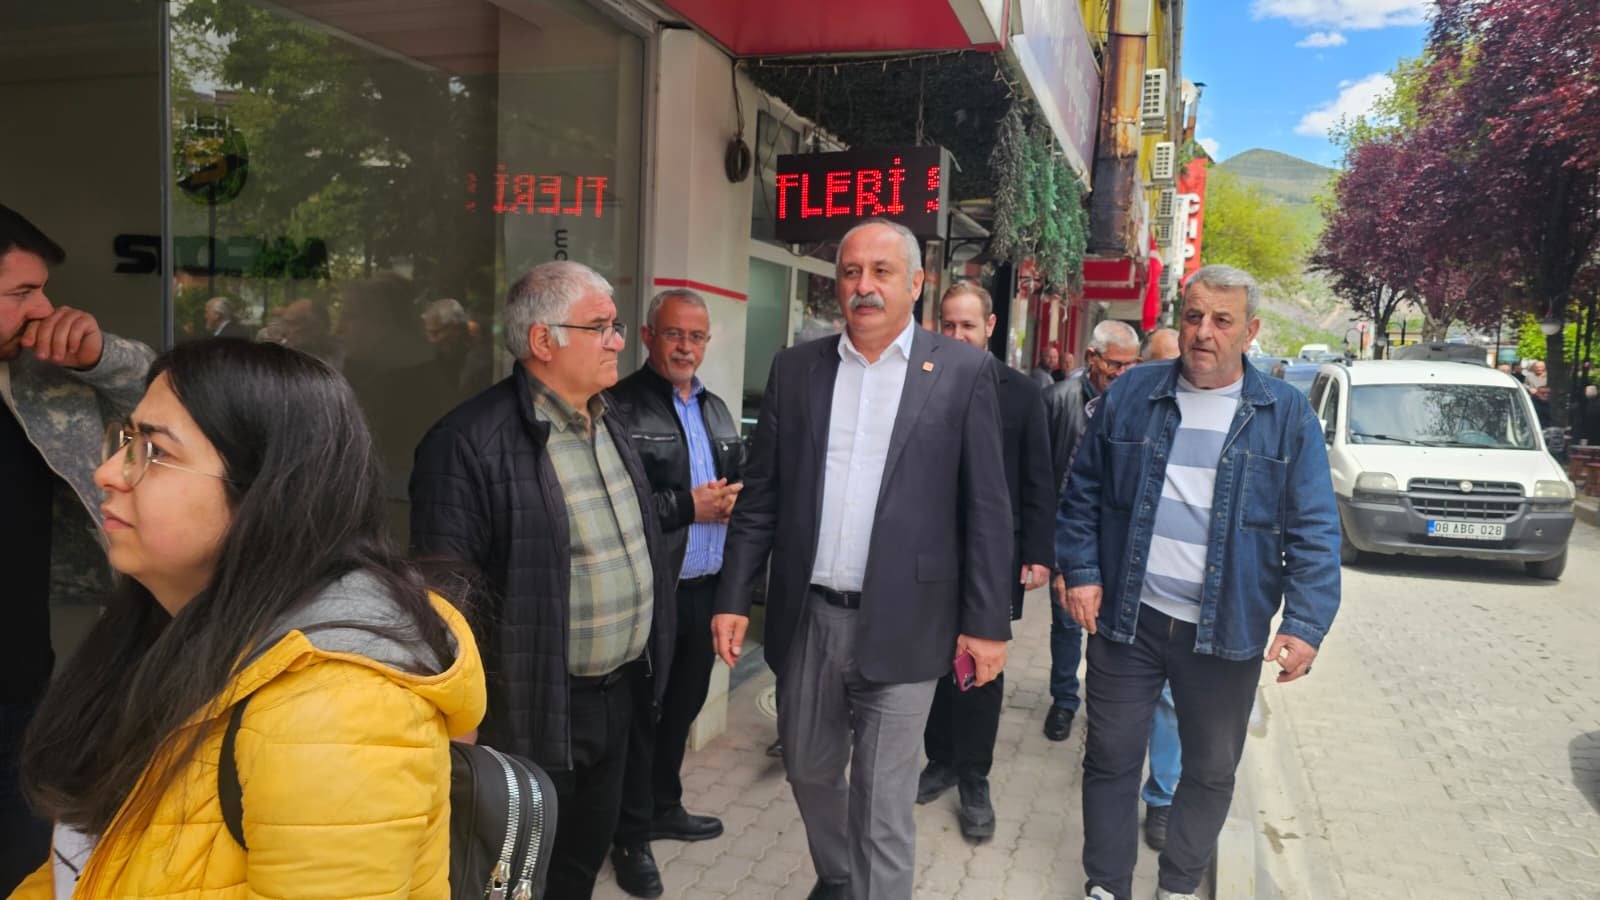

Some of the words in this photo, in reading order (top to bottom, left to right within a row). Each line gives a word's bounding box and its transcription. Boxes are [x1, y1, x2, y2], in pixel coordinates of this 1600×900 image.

[1435, 522, 1449, 533] 08
[1453, 523, 1475, 534] ABG
[1480, 525, 1502, 536] 028
